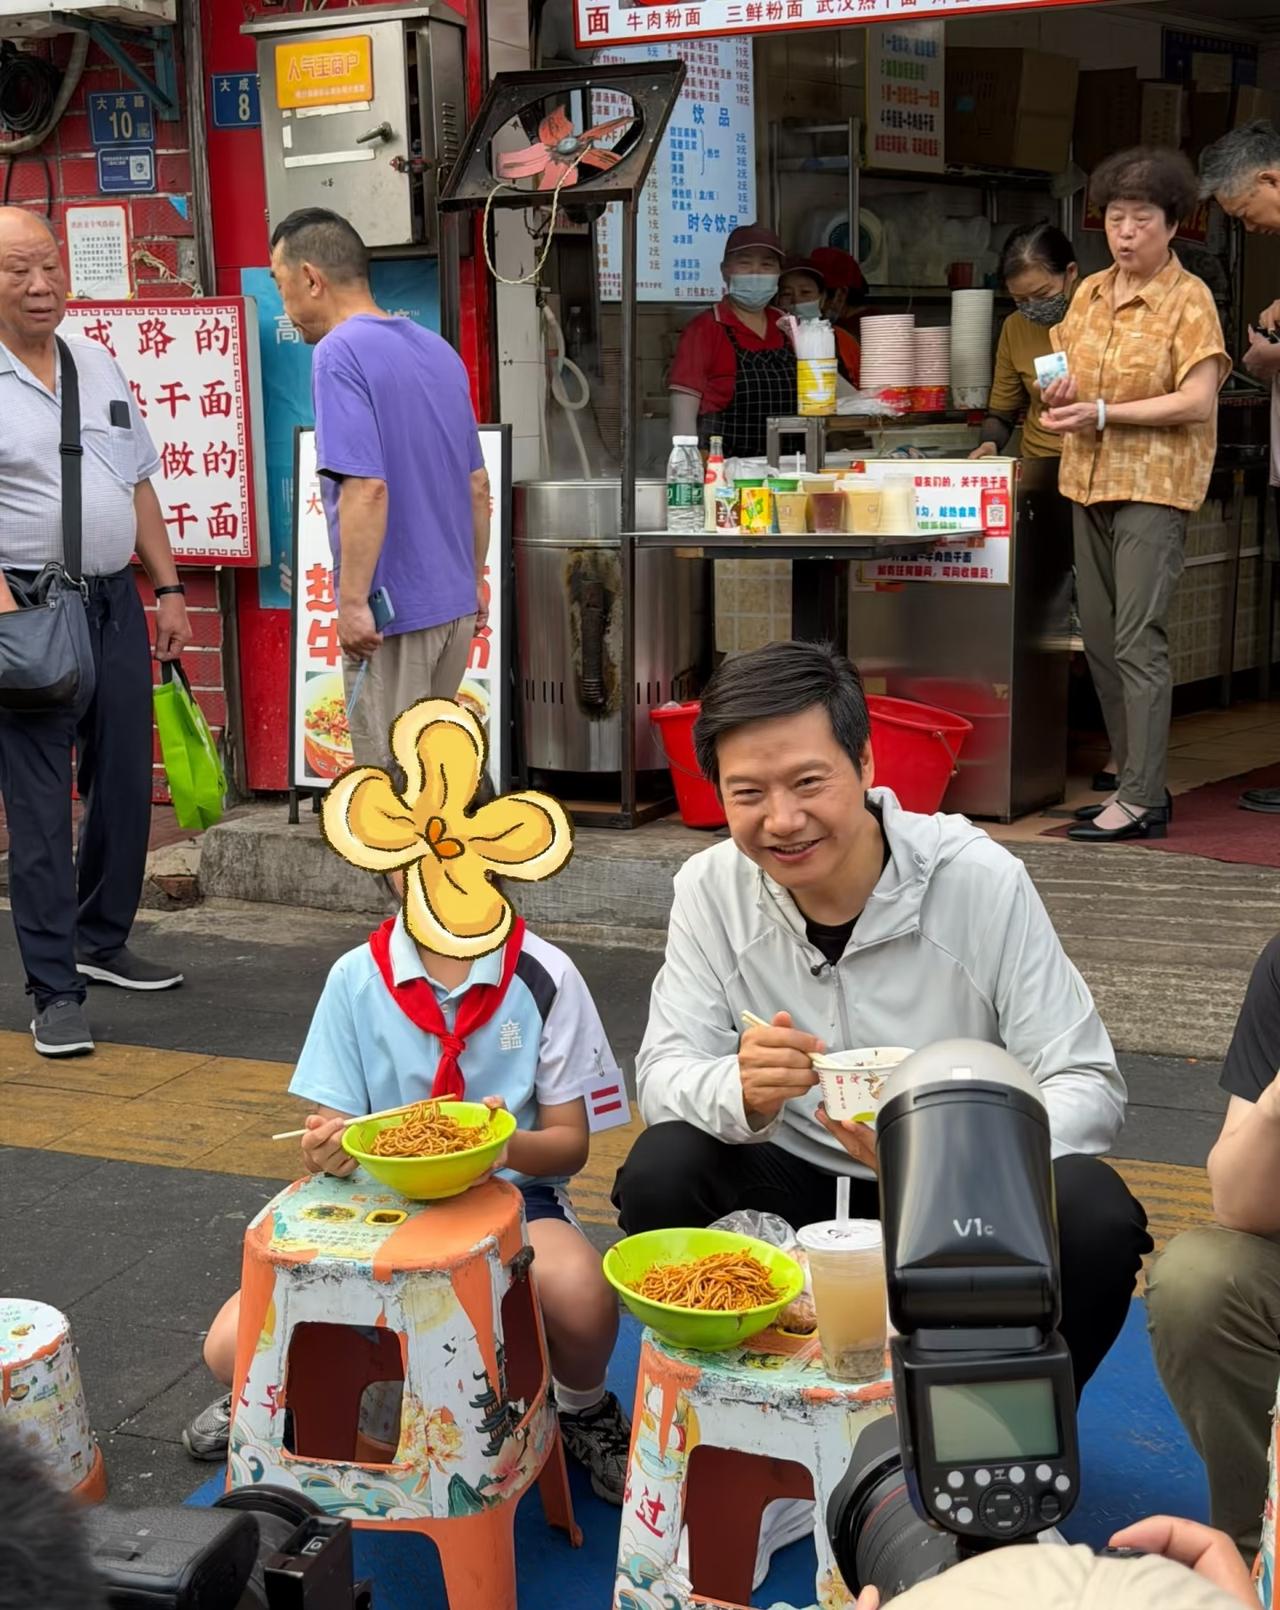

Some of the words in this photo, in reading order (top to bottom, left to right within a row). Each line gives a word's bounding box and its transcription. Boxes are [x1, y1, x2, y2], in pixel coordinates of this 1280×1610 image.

[585, 6, 611, 35] 面
[627, 7, 702, 32] 牛肉粉面
[726, 0, 804, 23] 三鲜粉面
[238, 93, 251, 121] 8
[109, 111, 134, 139] 10
